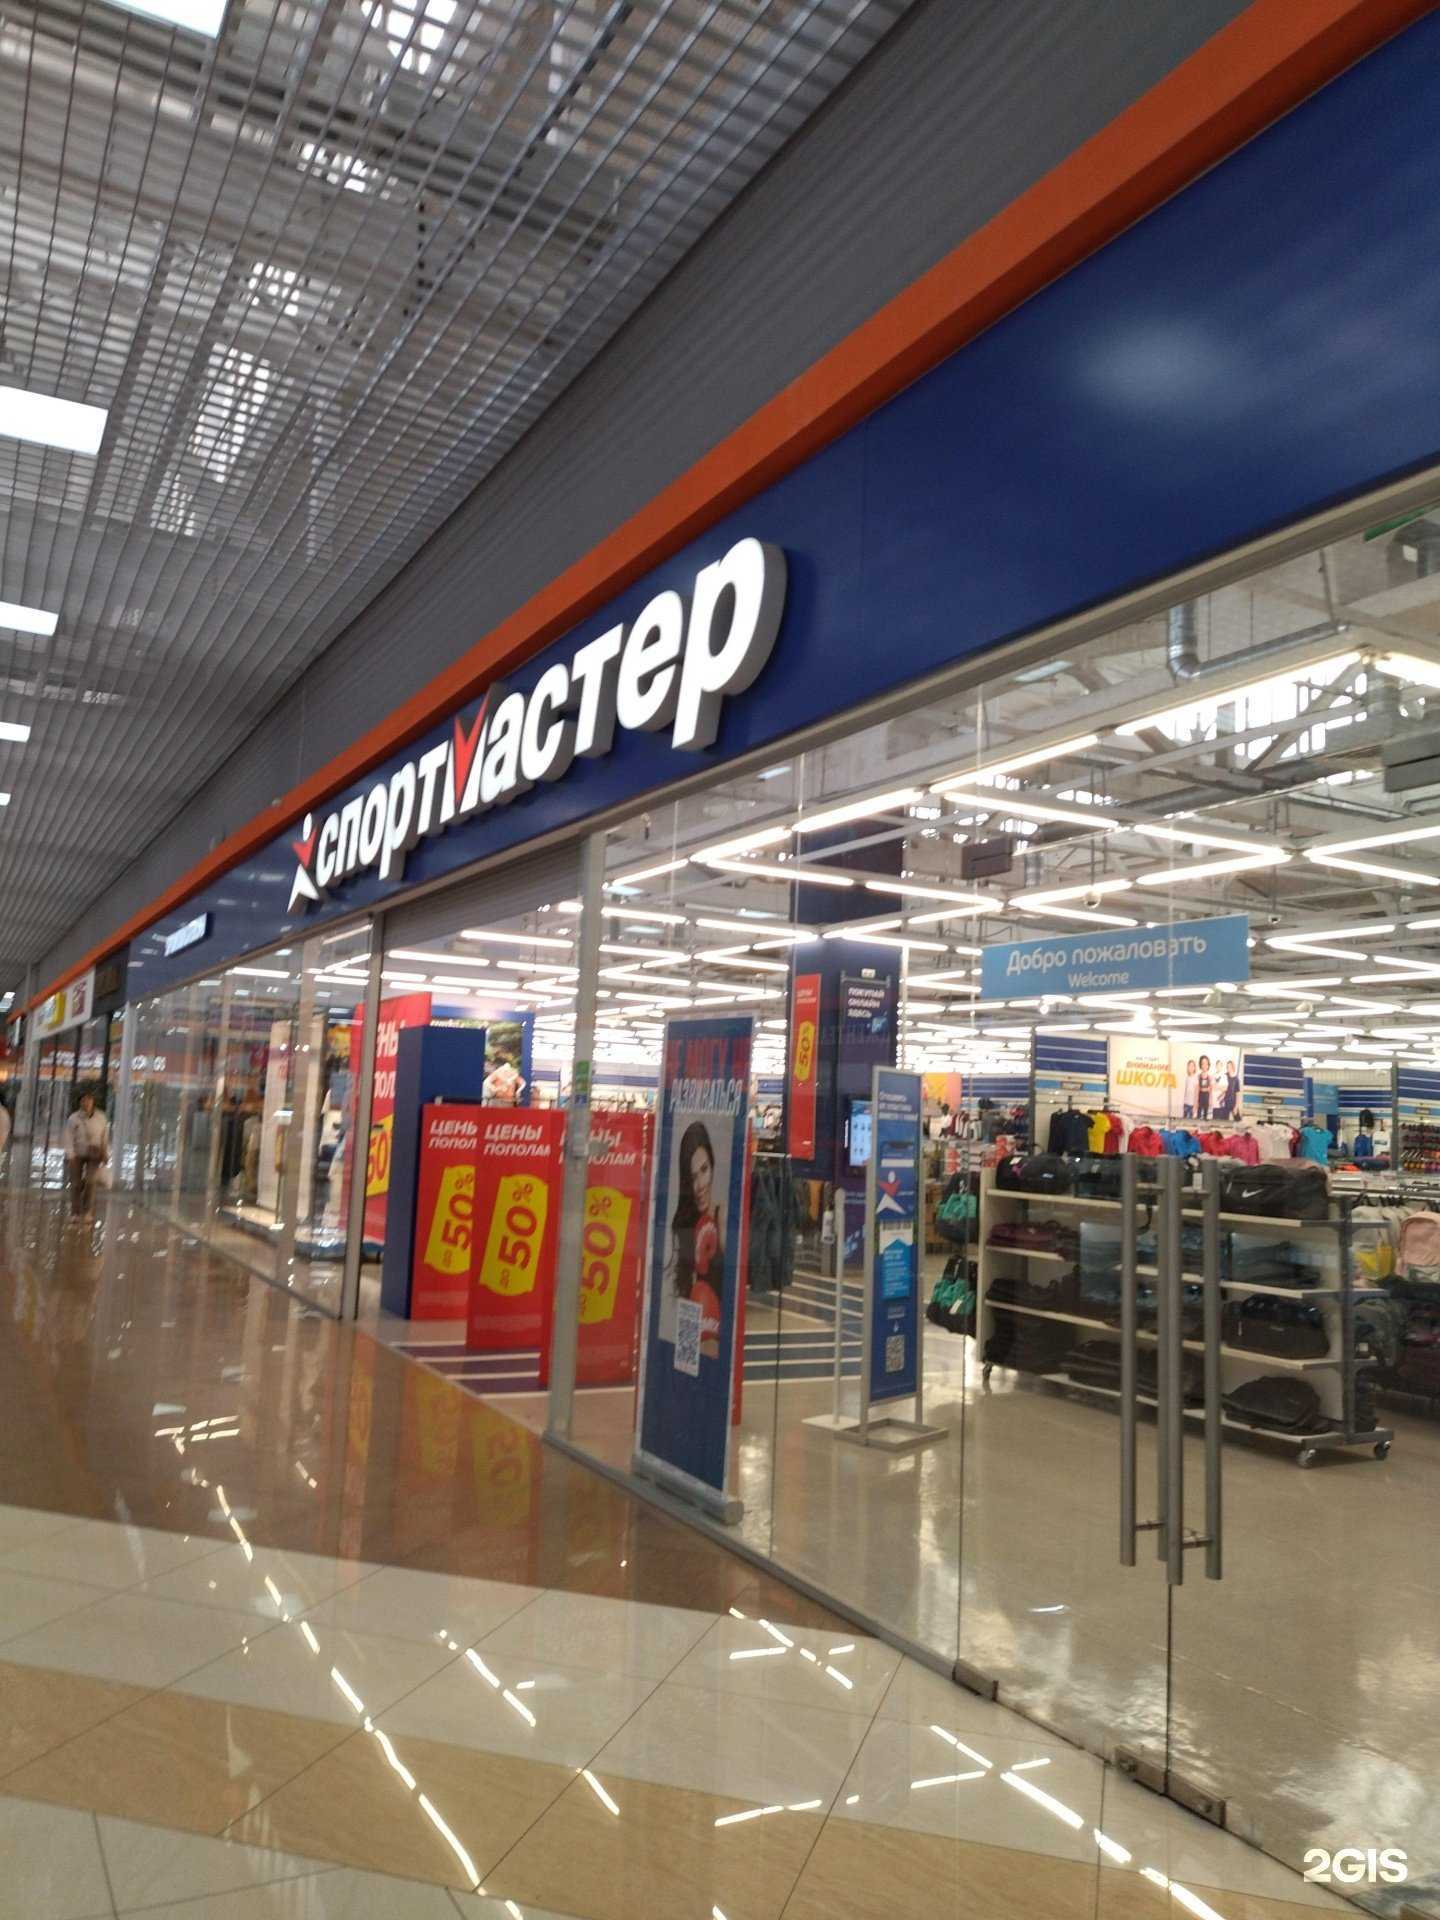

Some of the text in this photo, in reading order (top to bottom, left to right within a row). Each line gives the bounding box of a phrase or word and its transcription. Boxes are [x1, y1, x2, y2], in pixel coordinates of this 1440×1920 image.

[1006, 935, 1207, 976] Добро пожаловать
[1068, 971, 1129, 988] Welcome
[1116, 1070, 1177, 1089] ШКОЛА
[485, 1124, 543, 1142] ЦЕНЫ
[428, 1137, 477, 1149] ПОПОЛ
[498, 1182, 538, 1271] 50%
